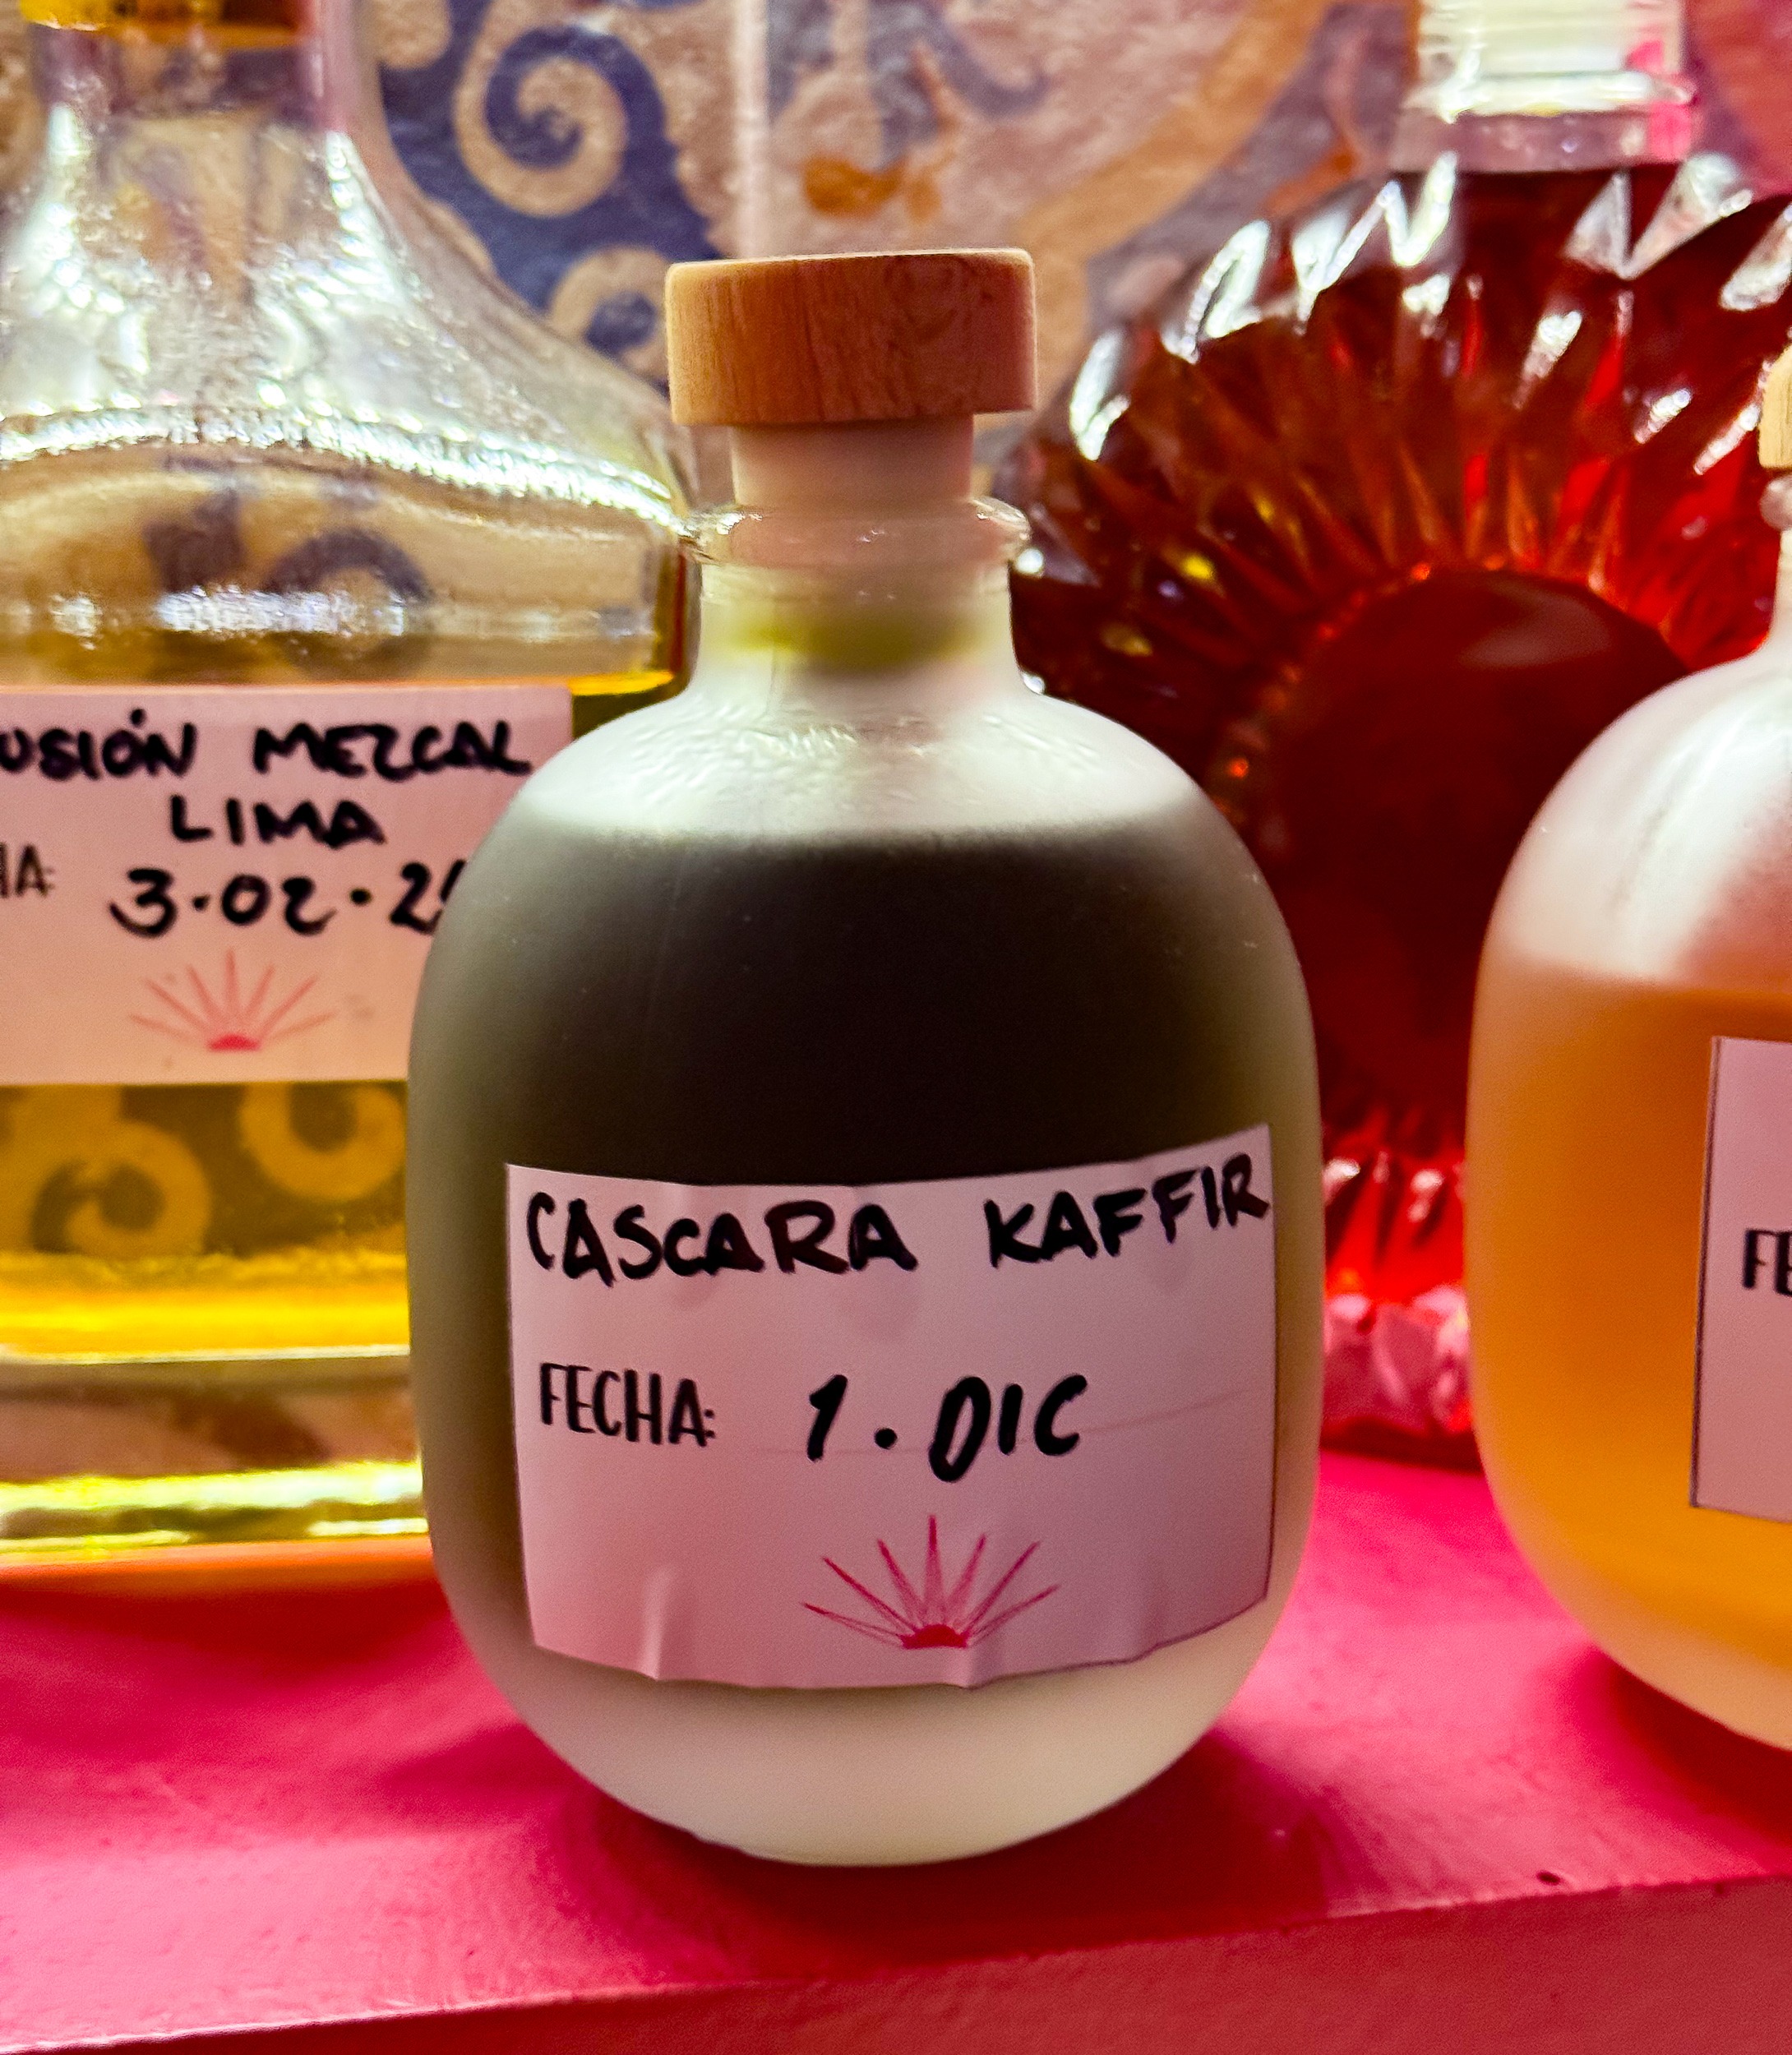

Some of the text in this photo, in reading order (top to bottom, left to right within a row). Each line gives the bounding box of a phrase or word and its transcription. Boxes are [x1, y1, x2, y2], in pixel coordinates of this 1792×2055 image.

[253, 720, 533, 782] MEZCAL
[170, 794, 386, 848] LIMA
[527, 1152, 1270, 1288] CASCARA KAFFIR
[539, 1362, 716, 1448] FECHA:
